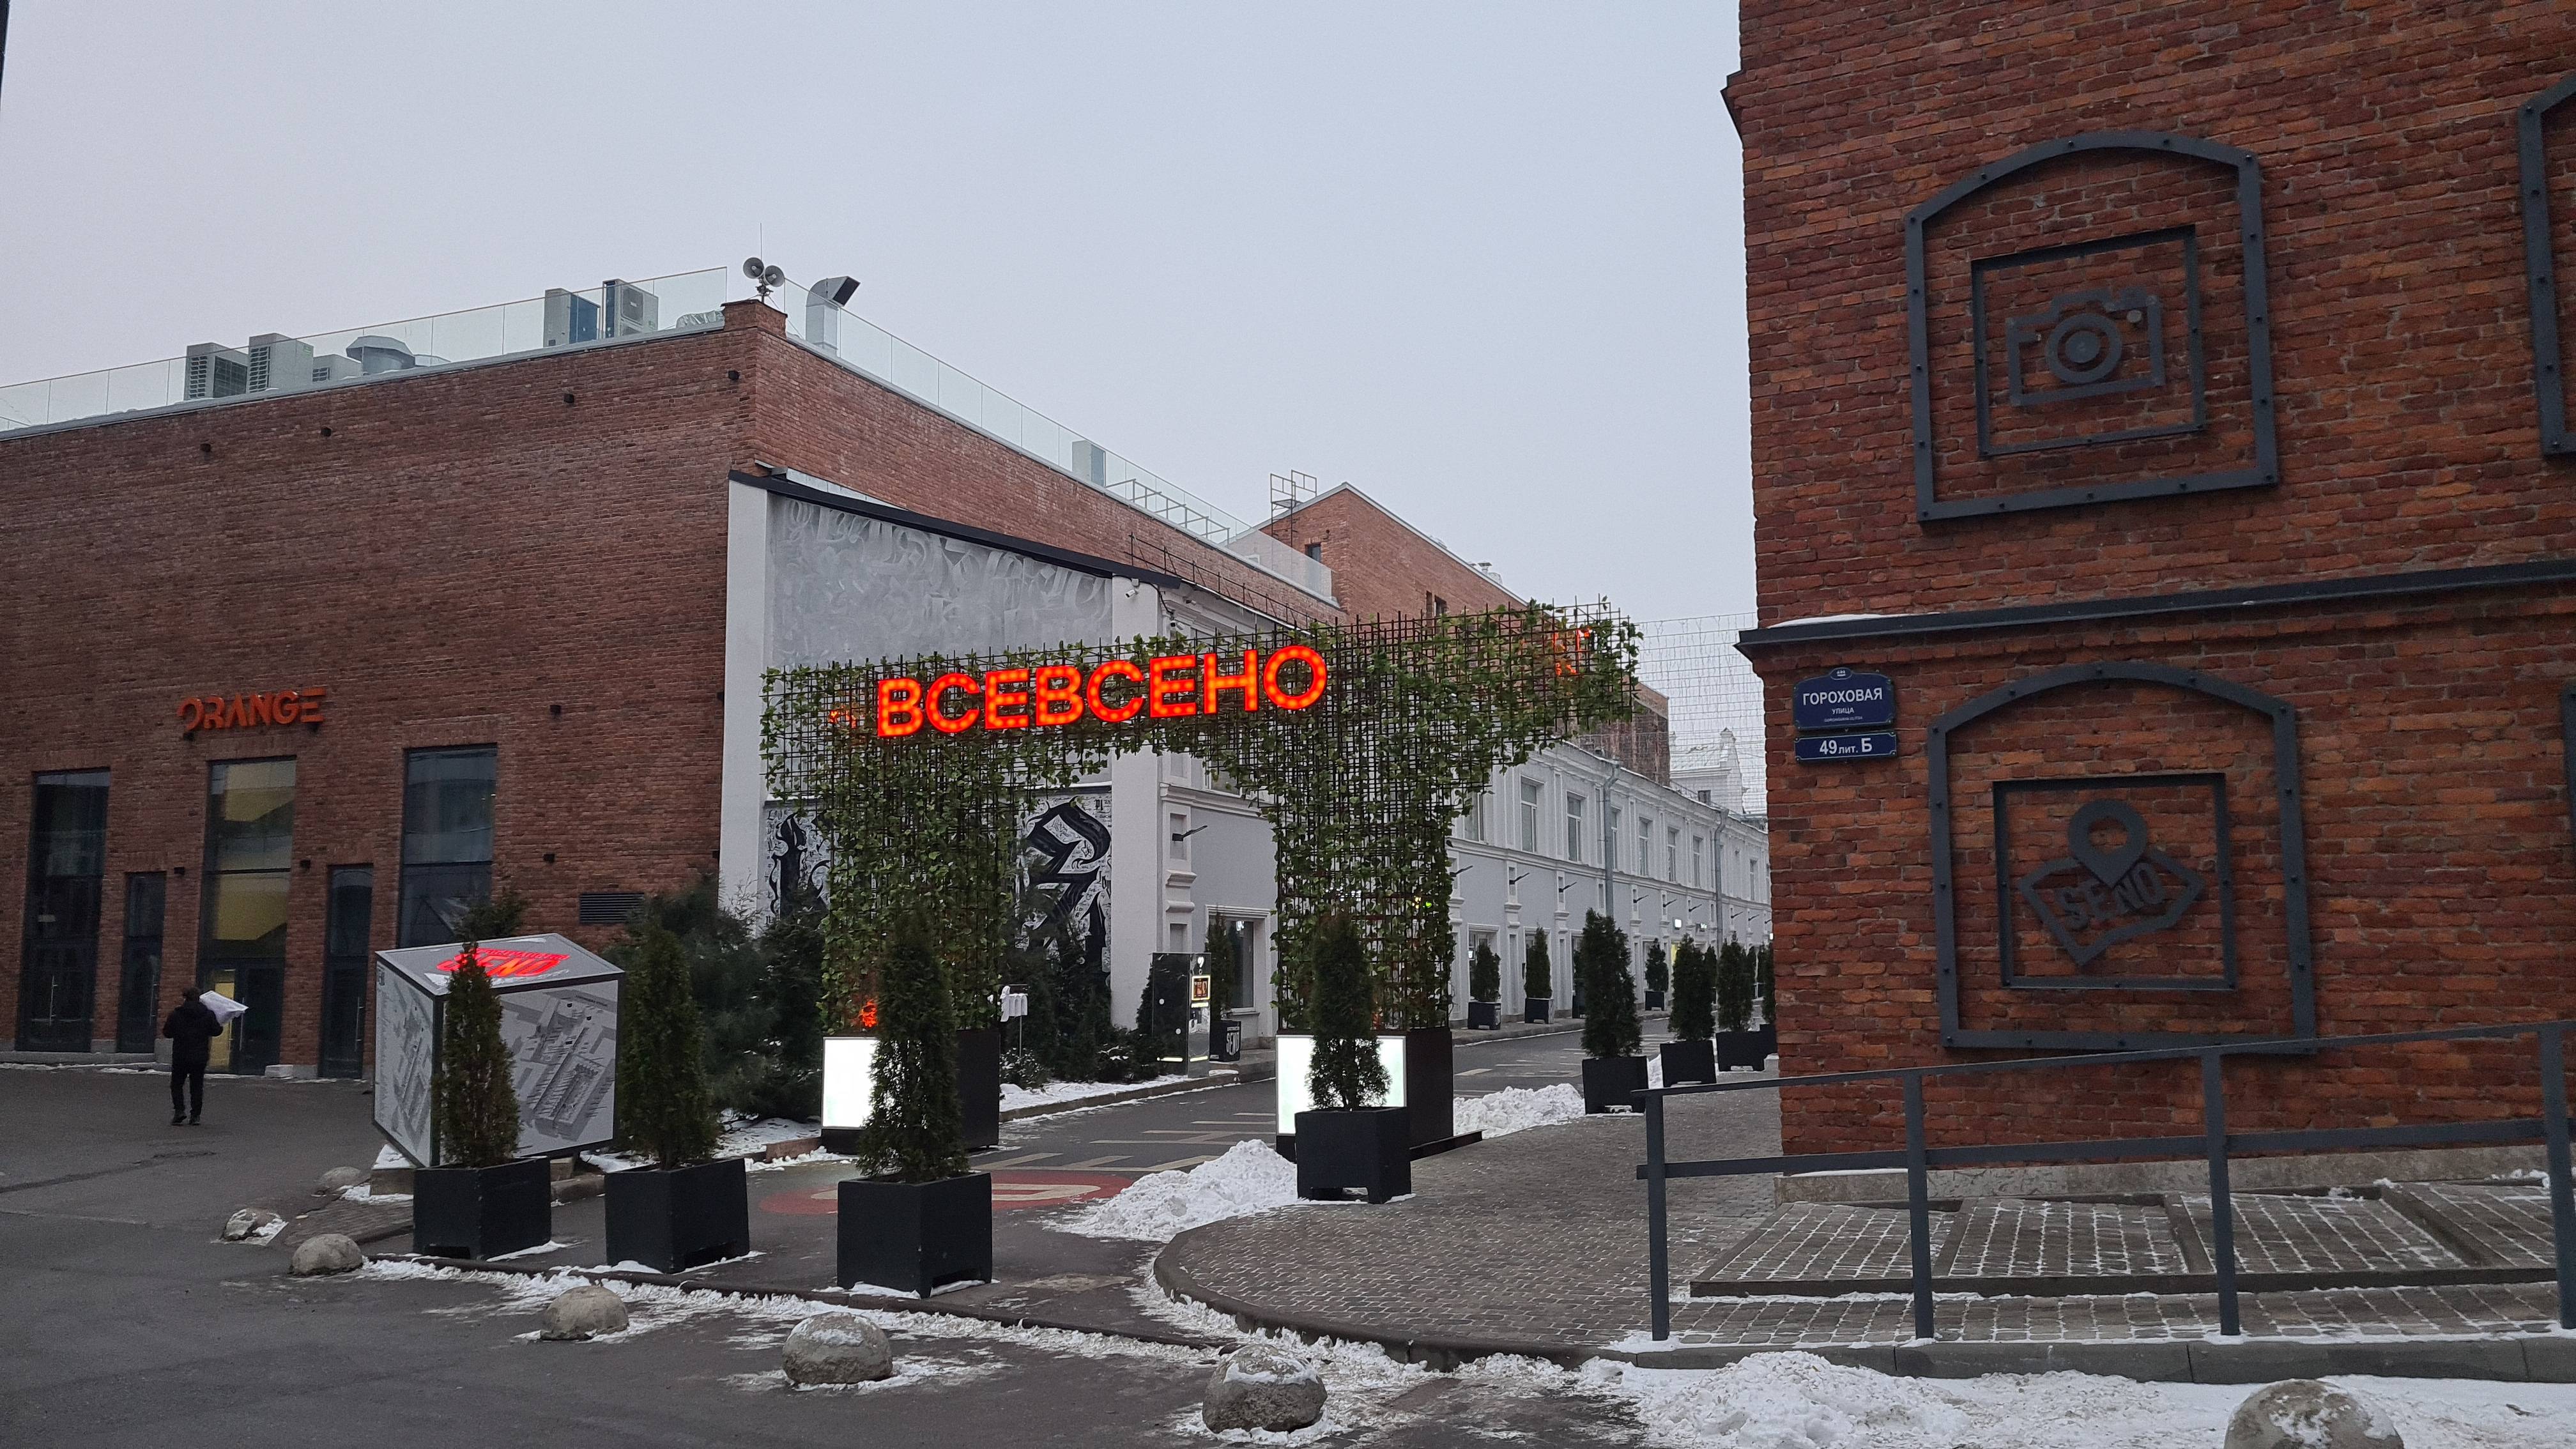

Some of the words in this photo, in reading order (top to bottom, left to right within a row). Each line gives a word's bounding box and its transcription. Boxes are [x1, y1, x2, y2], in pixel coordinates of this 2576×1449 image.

[176, 687, 326, 731] ORANGE
[877, 645, 1328, 737] ВСЕВСЕНО
[1803, 687, 1883, 705] ГОРОХОВАЯ
[1861, 737, 1873, 753] Б
[2053, 862, 2166, 930] SENO
